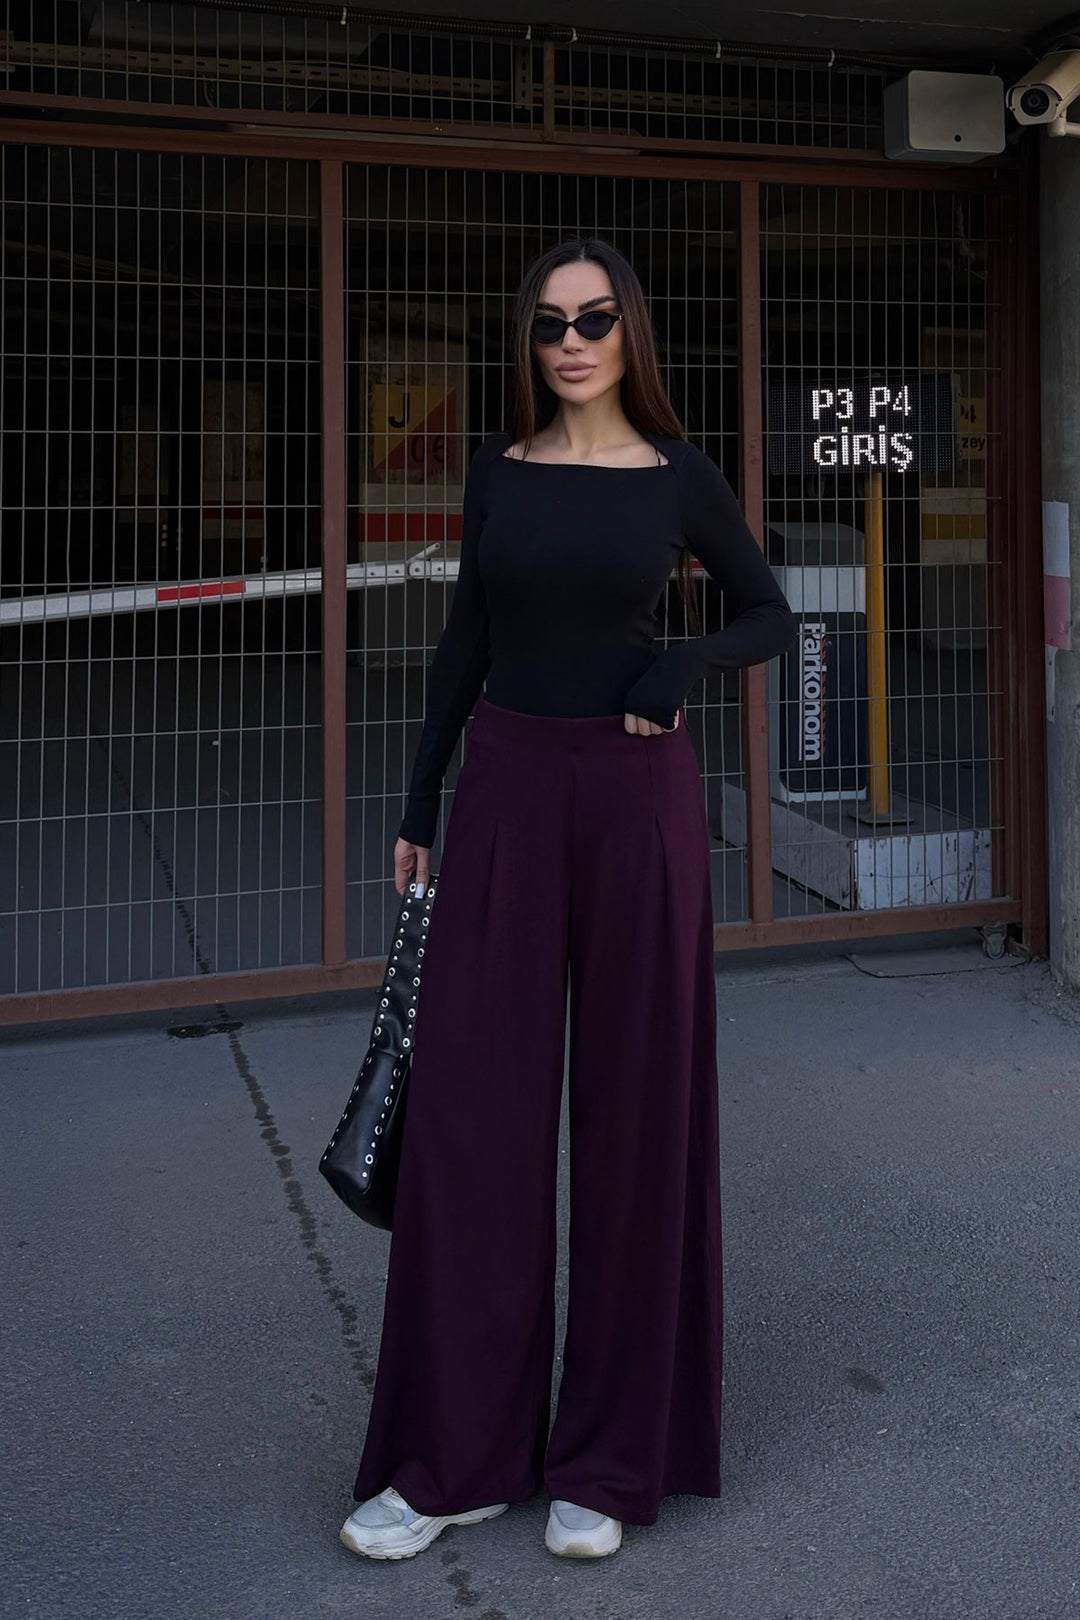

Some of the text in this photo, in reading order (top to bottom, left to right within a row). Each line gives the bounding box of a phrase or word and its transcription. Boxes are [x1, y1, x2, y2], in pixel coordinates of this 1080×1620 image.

[388, 391, 410, 428] J
[812, 385, 912, 420] P3 P4
[803, 623, 828, 761] Parkonom
